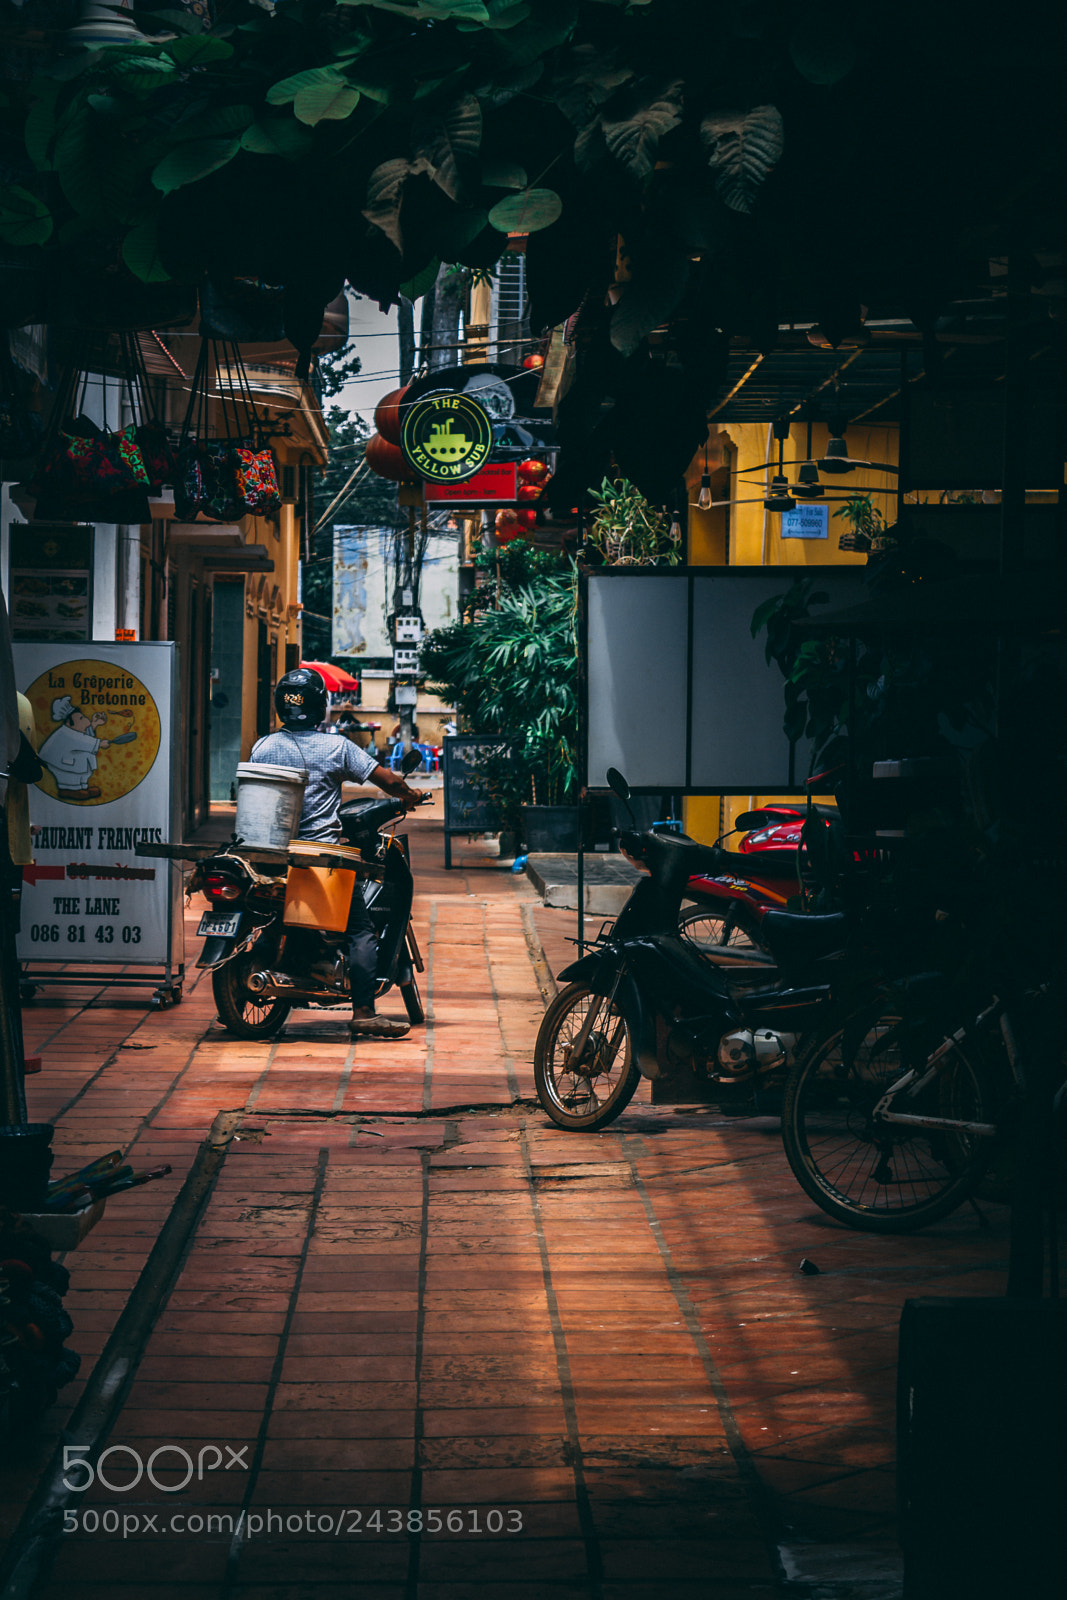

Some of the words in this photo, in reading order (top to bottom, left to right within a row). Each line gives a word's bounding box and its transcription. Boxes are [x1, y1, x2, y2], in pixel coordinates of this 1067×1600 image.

[432, 398, 461, 410] THE
[412, 445, 462, 476] YELLOW
[465, 443, 486, 468] SUB
[476, 468, 500, 476] ocktail
[444, 488, 461, 497] Open
[48, 672, 65, 689] La
[72, 672, 134, 693] Crêperie
[80, 689, 146, 705] Bretonne
[31, 826, 93, 850] TAURANT
[53, 897, 80, 915] THE
[85, 897, 120, 916] LANE
[30, 924, 59, 943] 086
[67, 924, 85, 943] 81
[94, 924, 114, 944] 43
[121, 925, 142, 944] 03
